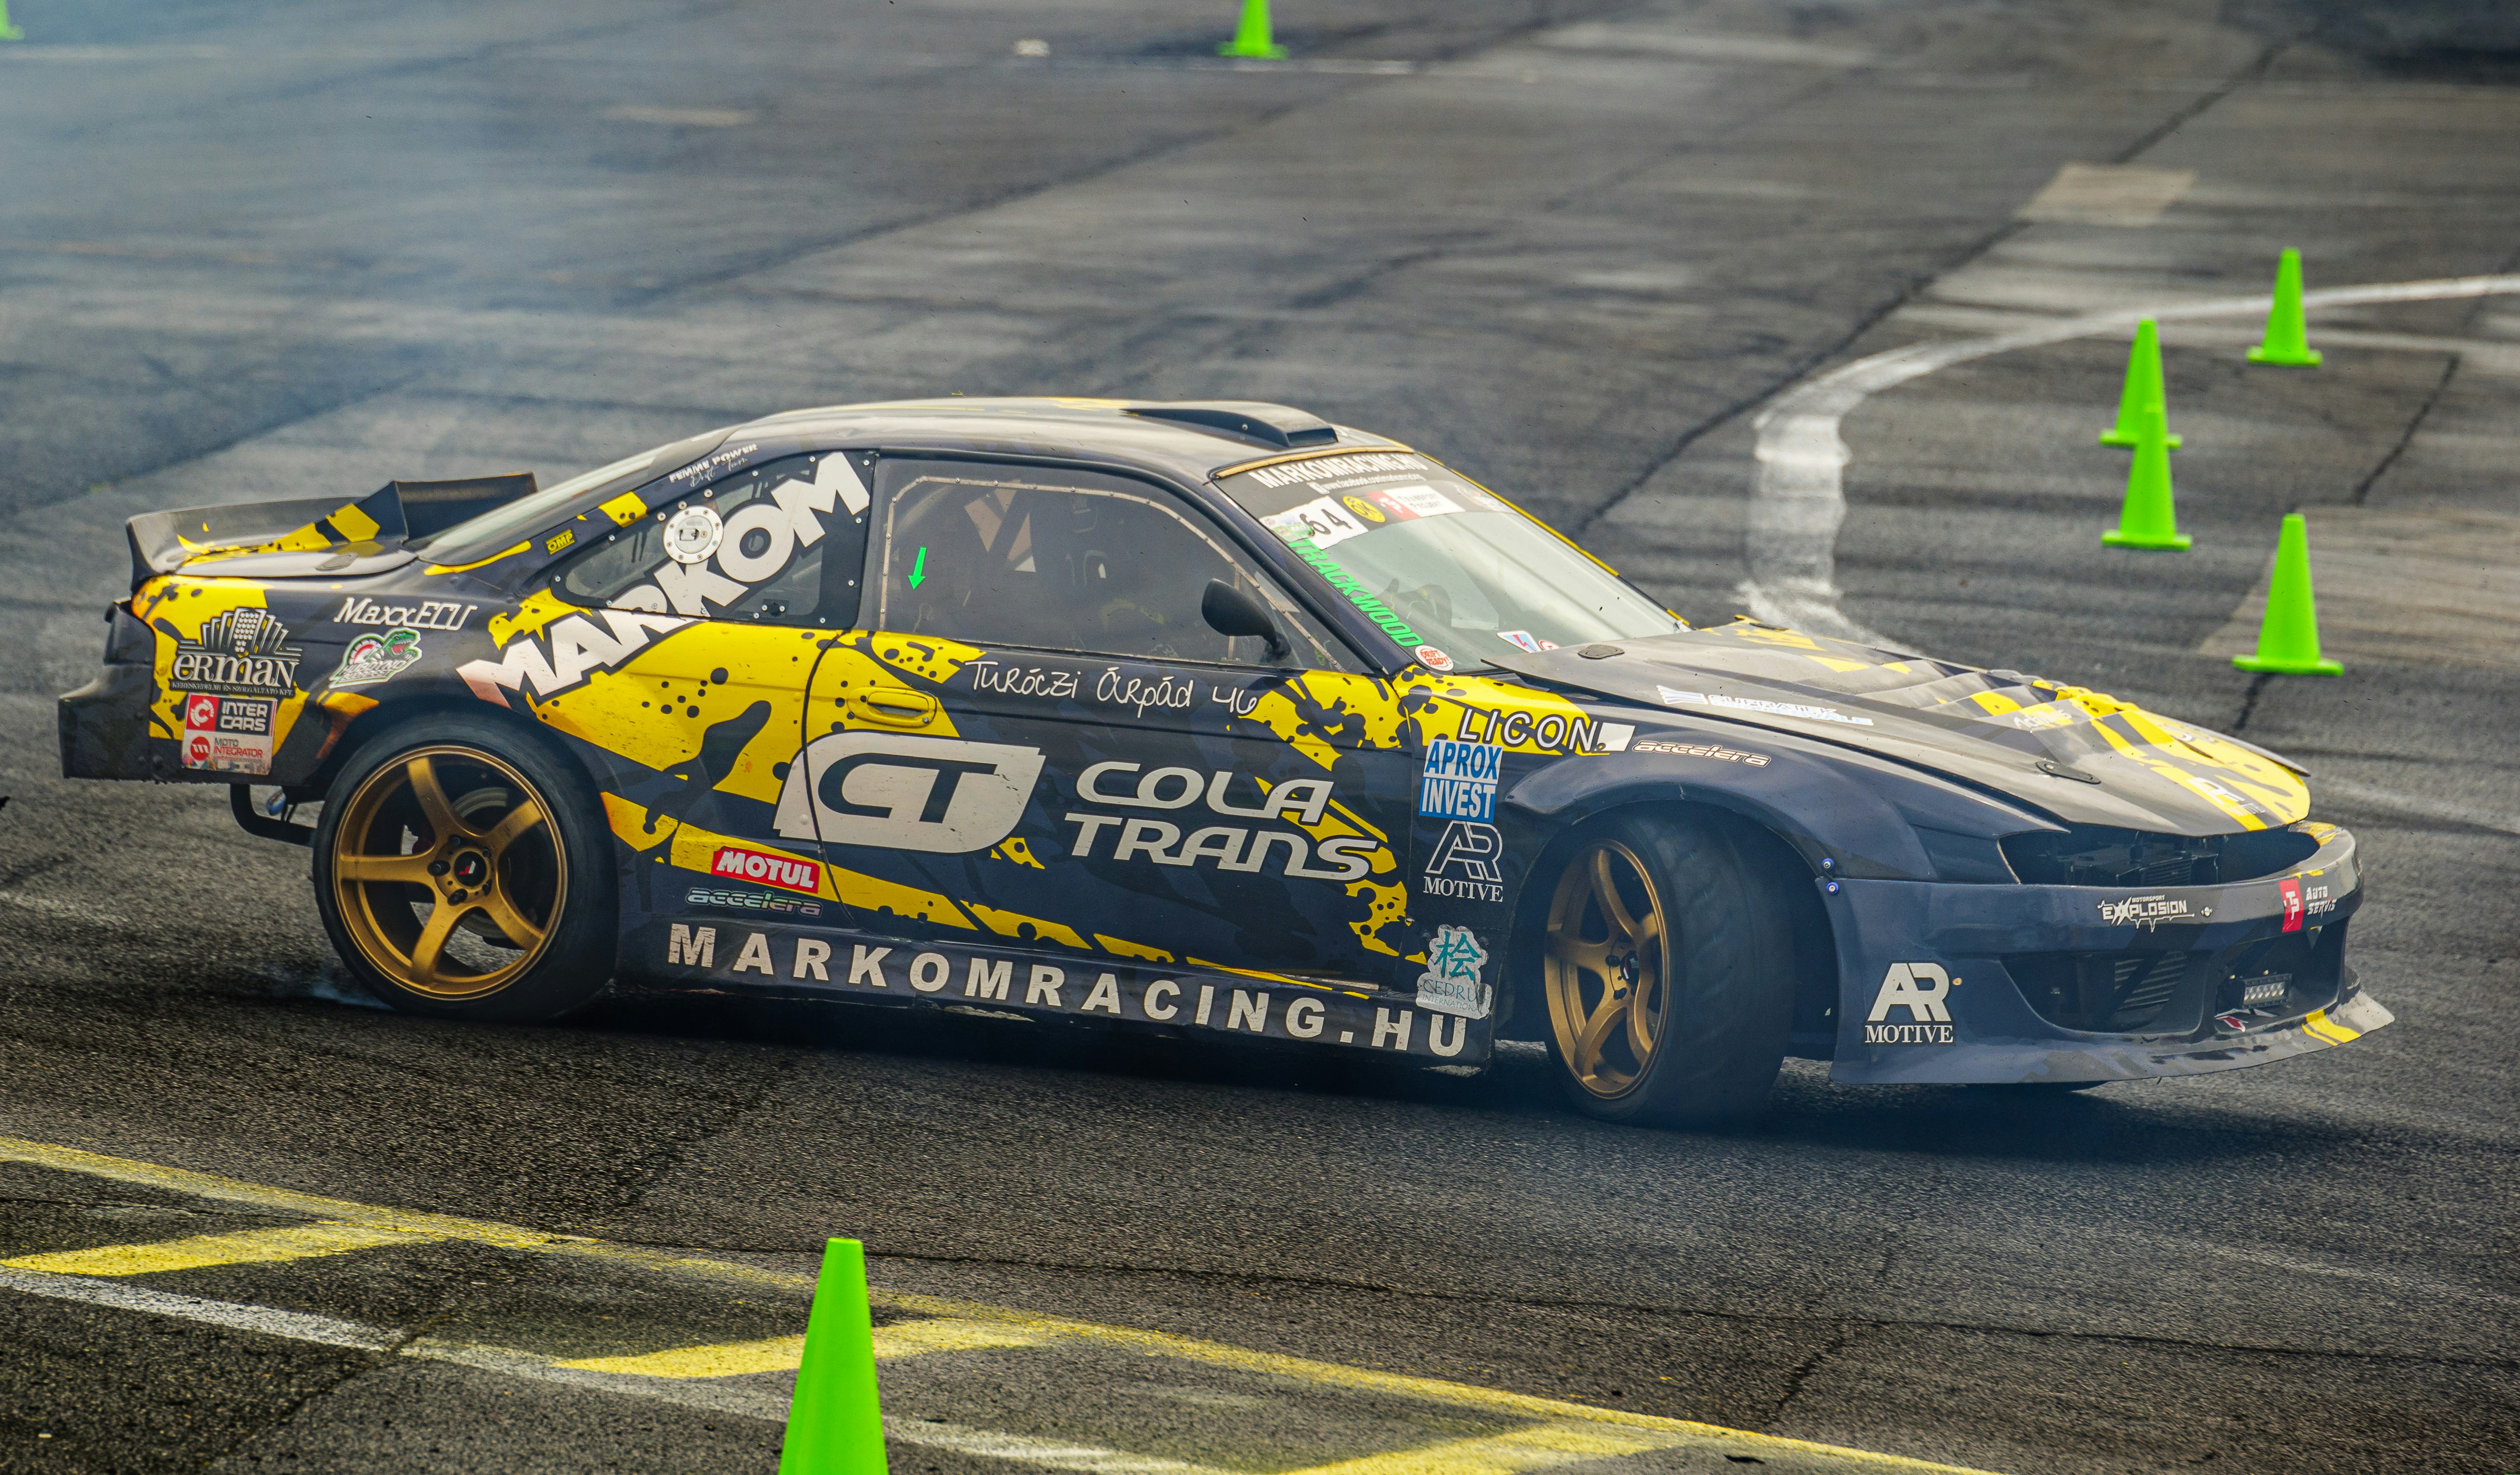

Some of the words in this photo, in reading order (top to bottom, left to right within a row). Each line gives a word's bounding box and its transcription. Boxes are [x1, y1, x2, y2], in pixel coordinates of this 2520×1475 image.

[669, 460, 710, 483] FEMME
[711, 444, 758, 465] POWER
[1300, 509, 1353, 535] 64
[547, 533, 573, 551] OMP
[456, 451, 870, 710] MARKOM
[1288, 538, 1424, 647] TRACKWOOD
[333, 597, 478, 631] MaxxECU
[1420, 650, 1442, 660] DRIFT
[1427, 657, 1452, 666] READY!
[221, 701, 268, 717] INTER
[1212, 686, 1257, 714] 46
[1708, 694, 1837, 715] SUPRATEK
[220, 715, 266, 732] CARS
[213, 745, 263, 758] INTEGRATOR
[214, 738, 239, 747] MOTO
[1632, 740, 1772, 767] accelera
[1425, 741, 1503, 780] APROX
[1076, 761, 1334, 823] COLA
[1421, 778, 1496, 819] INVEST
[1064, 813, 1378, 881] TRANS
[716, 850, 815, 888] MOTUL
[685, 888, 823, 917] accelera
[1423, 876, 1503, 903] MOTIVE
[2131, 895, 2165, 903] MOTORSPORT
[2306, 885, 2328, 901] AUTO
[2307, 898, 2338, 917] SERVIS
[667, 922, 1467, 1057] MARKOMRACING.HU
[1423, 979, 1486, 1004] CEDRU
[1867, 963, 1952, 1022] AR
[1864, 1024, 1953, 1044] MOTIVE
